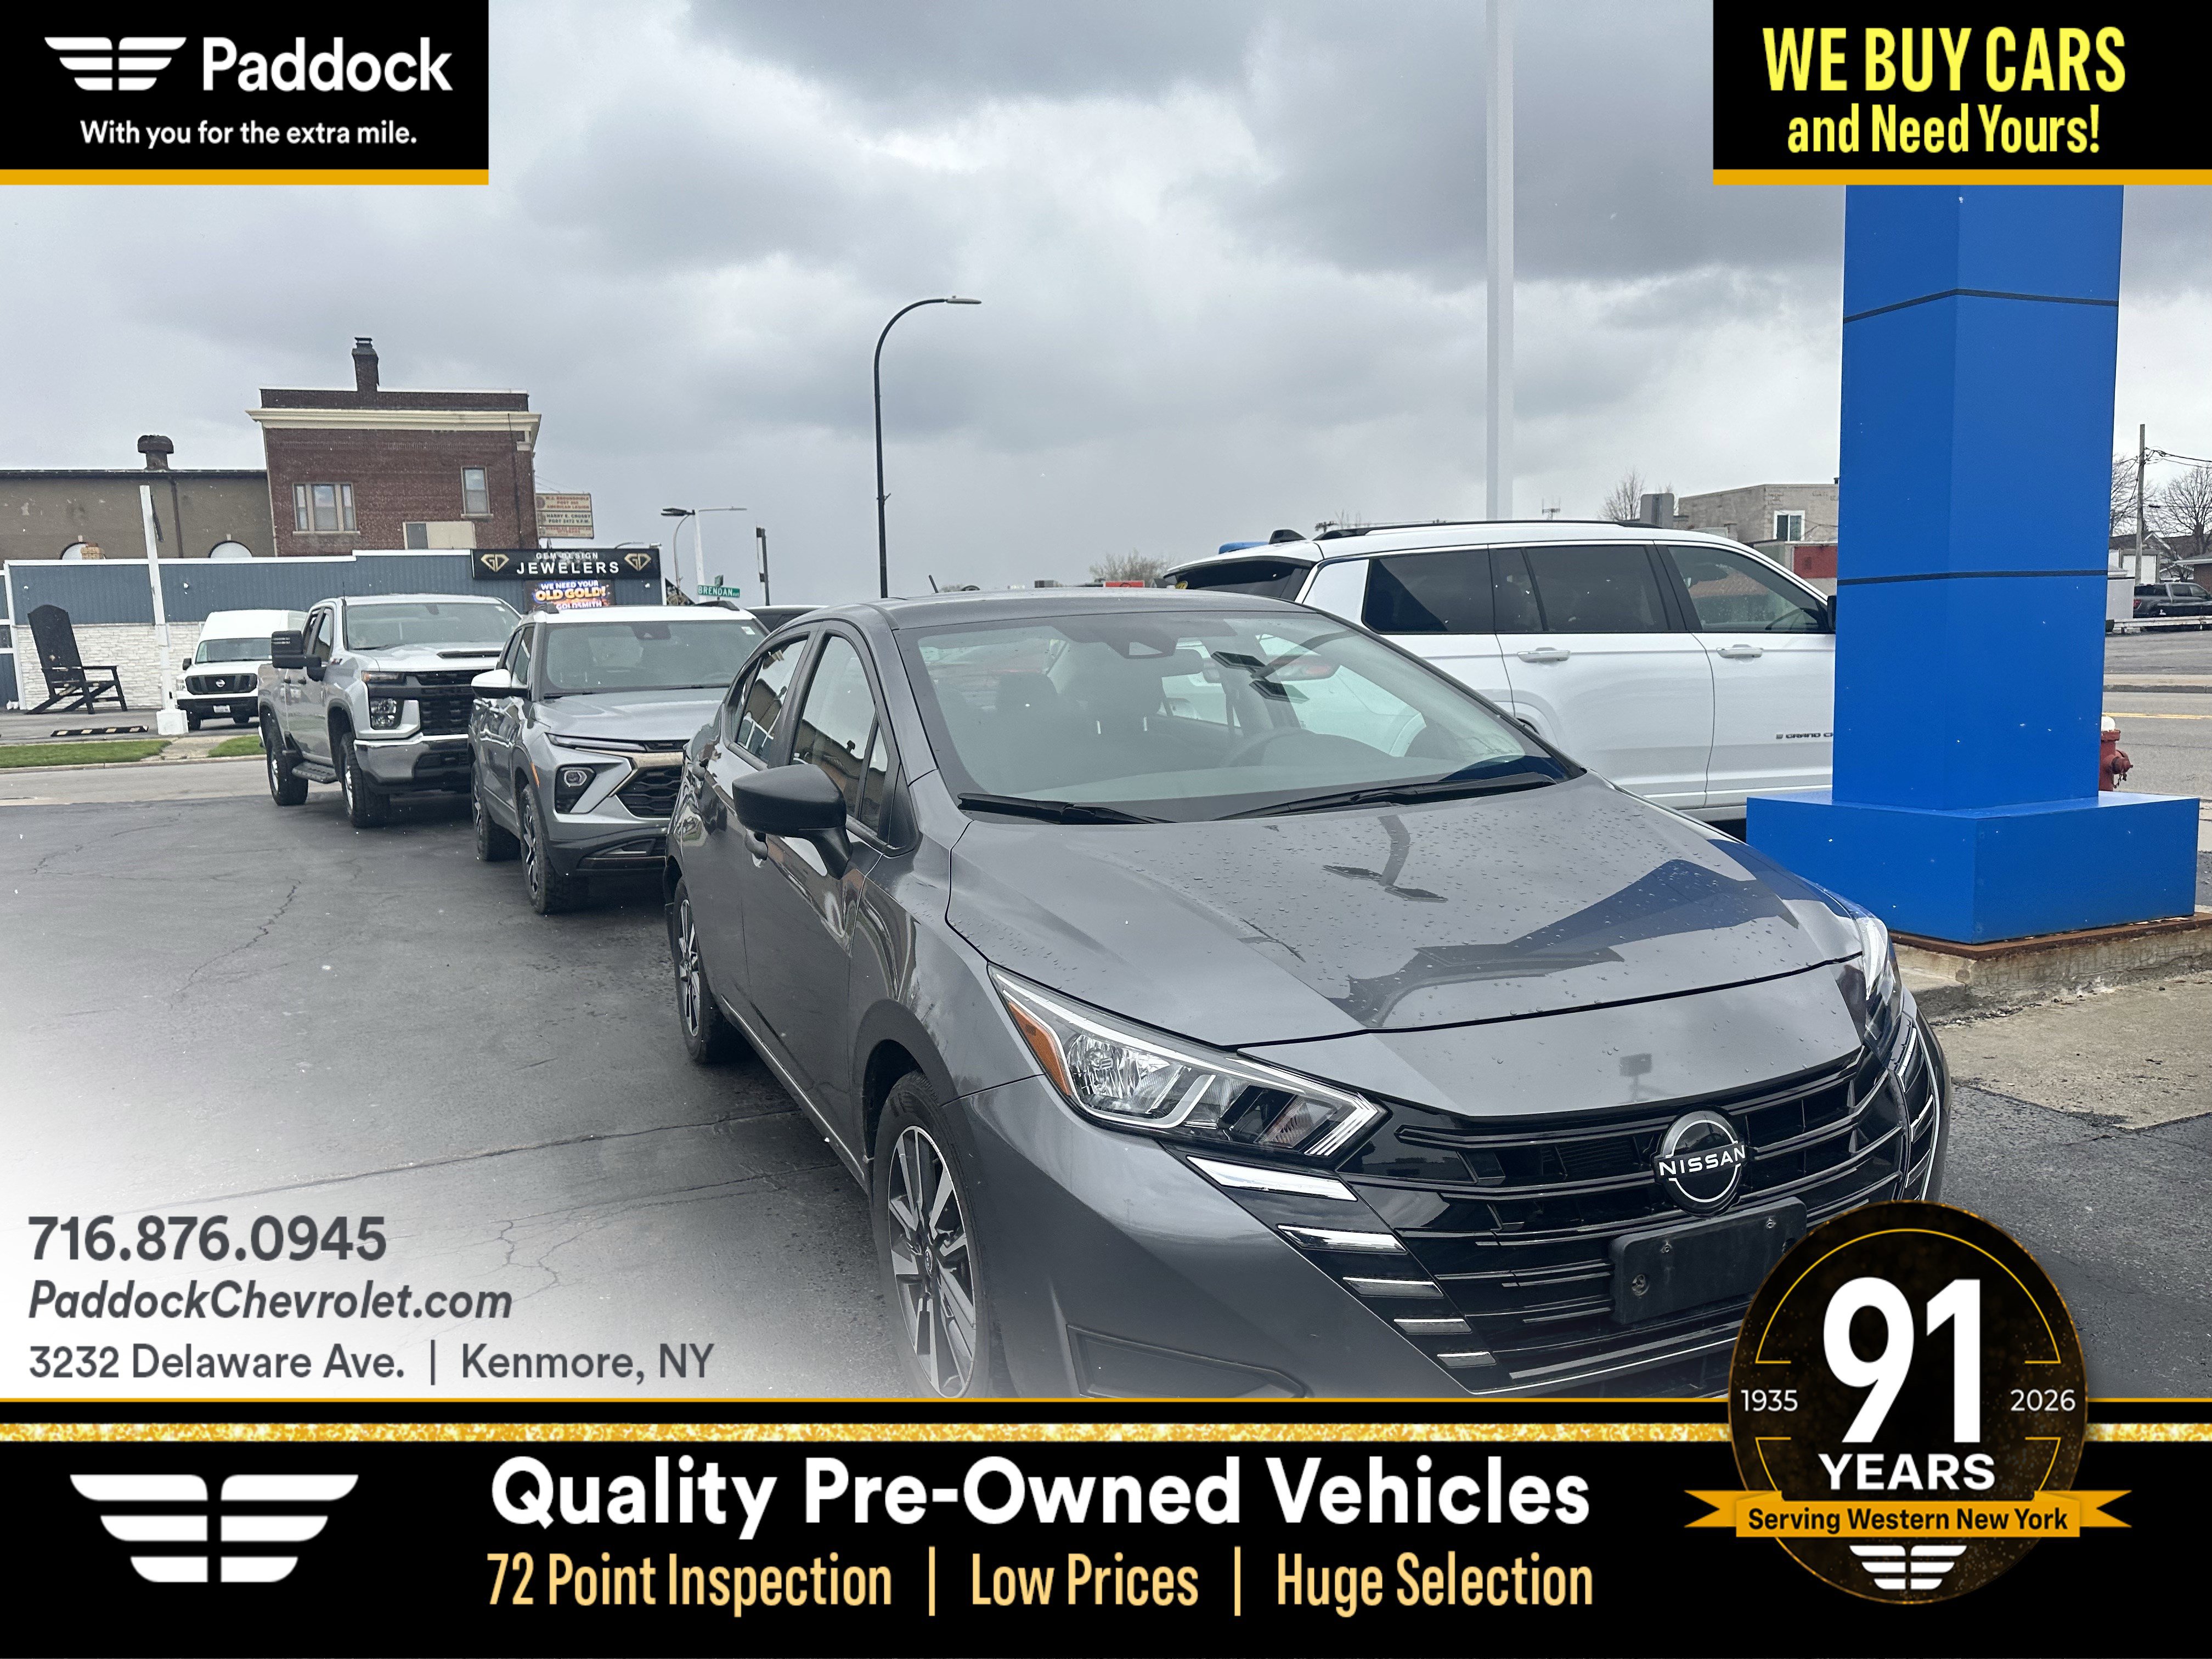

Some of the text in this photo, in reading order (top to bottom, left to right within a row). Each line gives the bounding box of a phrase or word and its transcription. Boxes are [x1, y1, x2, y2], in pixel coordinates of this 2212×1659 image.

[561, 551, 599, 560] DESIGN
[516, 561, 619, 574] JEWELERS
[555, 581, 577, 590] NEED
[578, 580, 599, 588] YOUR
[698, 585, 733, 596] BRENDAN
[535, 585, 606, 601] OLD GOLD!
[556, 600, 603, 610] GOLDSMITH
[1658, 1144, 1746, 1176] NISSAN
